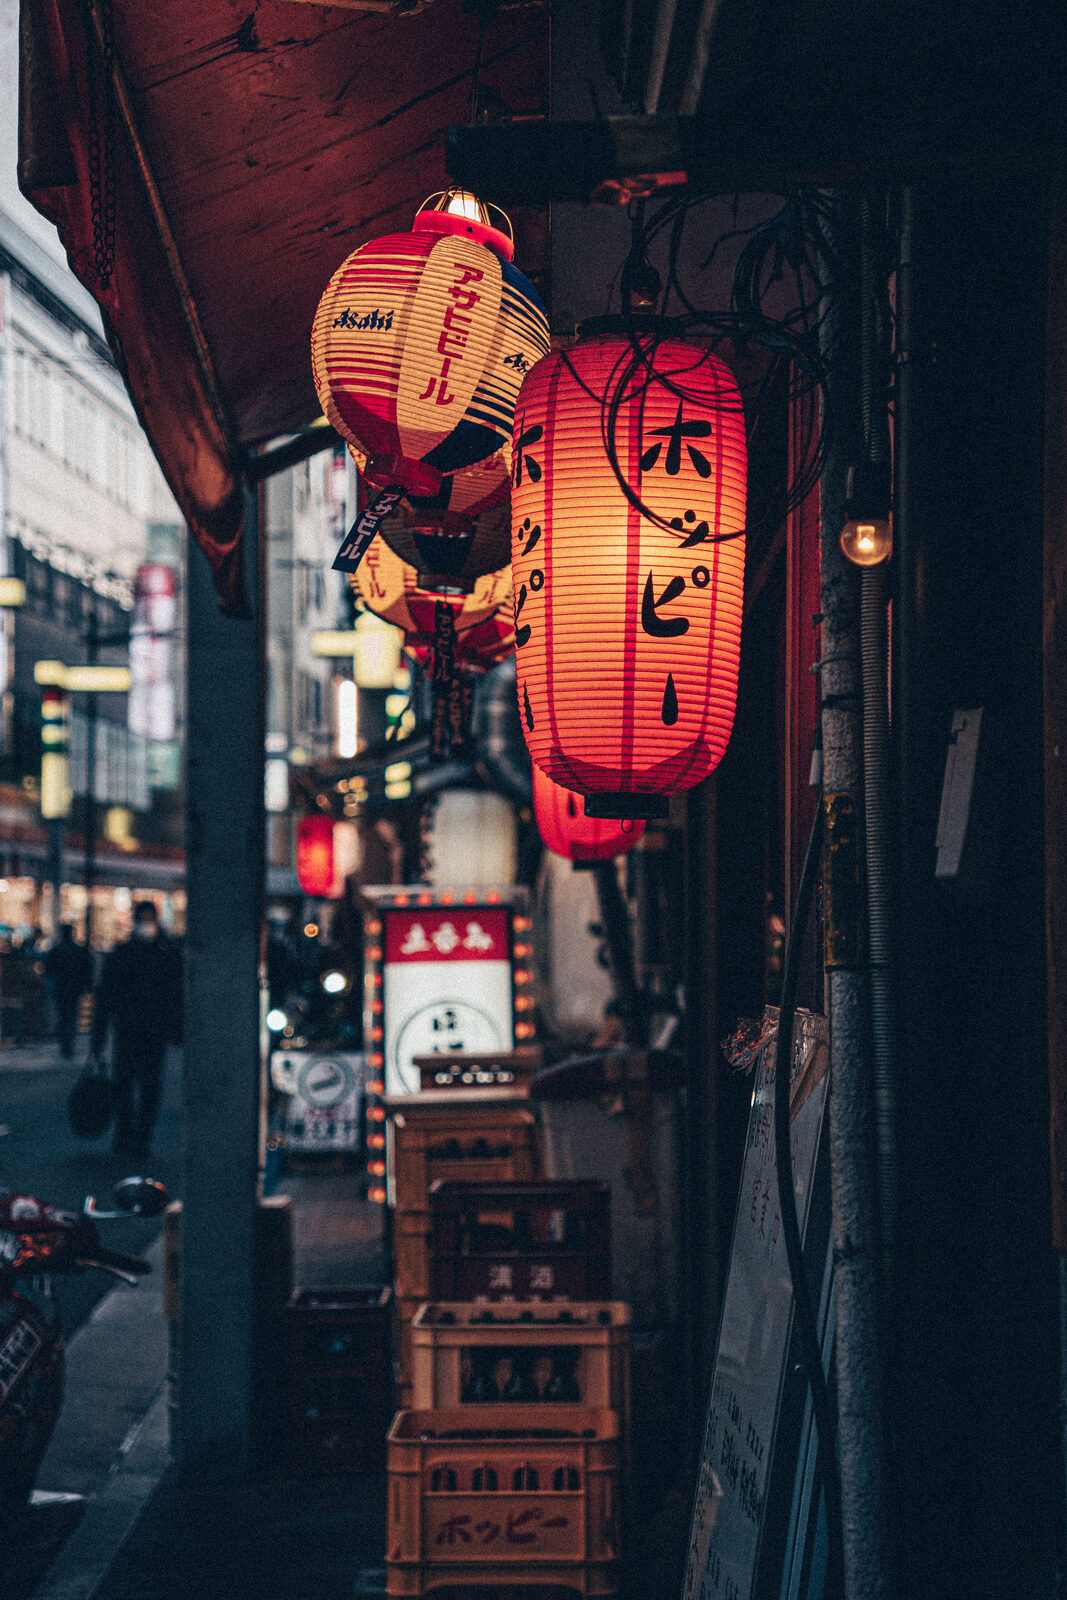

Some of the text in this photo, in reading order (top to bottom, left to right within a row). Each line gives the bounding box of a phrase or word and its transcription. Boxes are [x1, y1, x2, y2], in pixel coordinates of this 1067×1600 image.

[332, 307, 394, 332] Asahi
[419, 264, 483, 405] アサヒビール
[503, 352, 529, 375] As
[339, 493, 400, 560] アサヒビール
[640, 401, 712, 726] ホッピー
[435, 1507, 569, 1545] ホッピー
